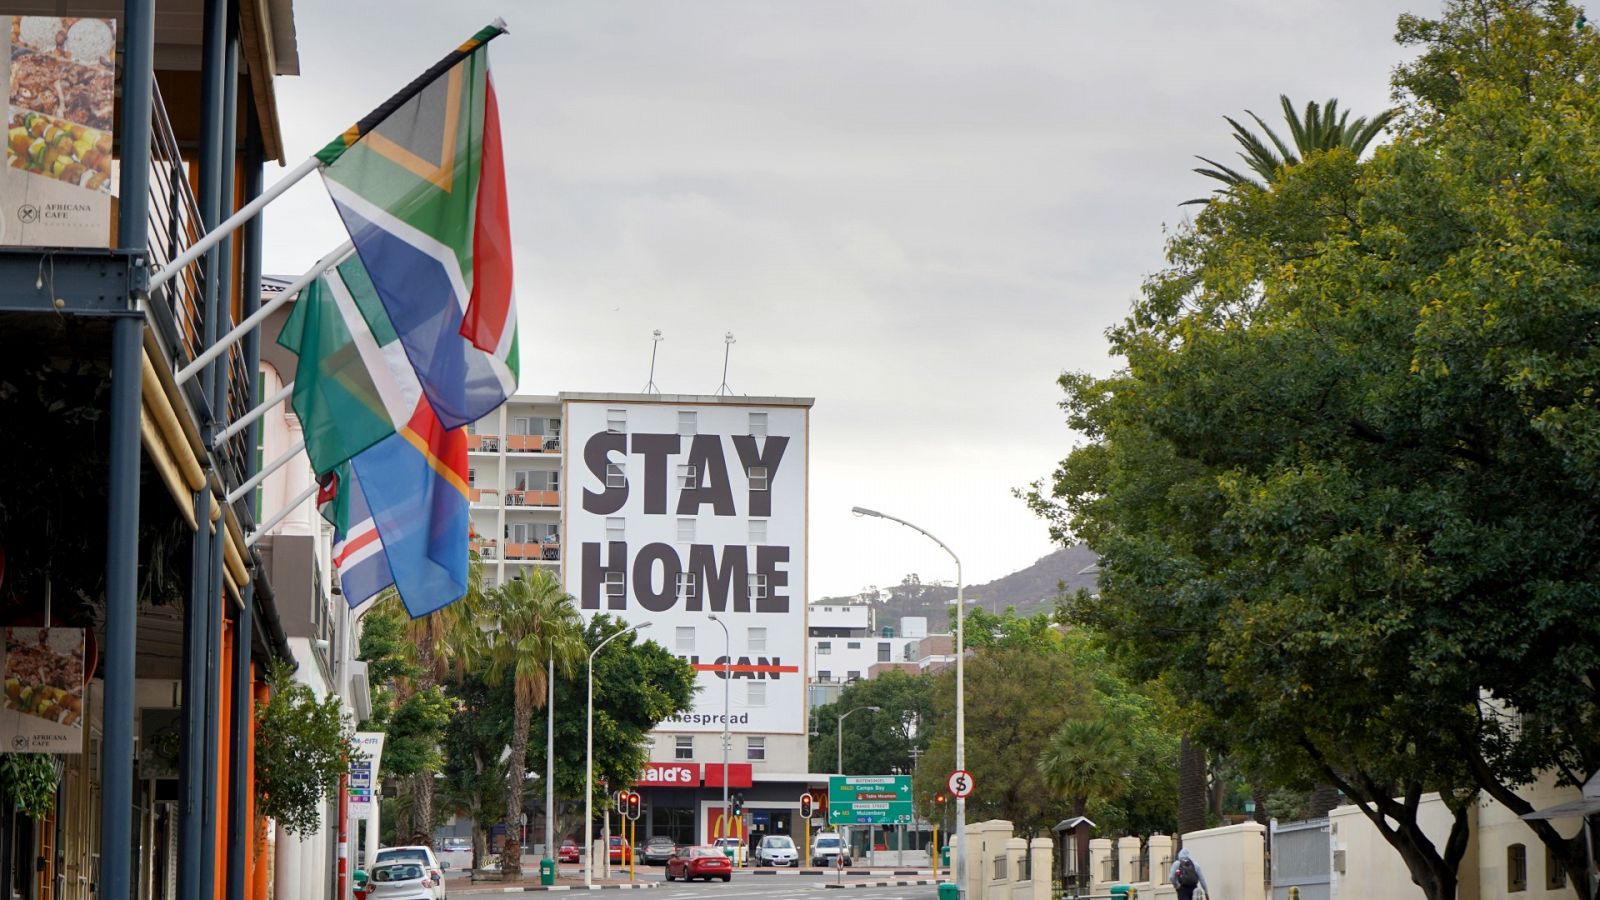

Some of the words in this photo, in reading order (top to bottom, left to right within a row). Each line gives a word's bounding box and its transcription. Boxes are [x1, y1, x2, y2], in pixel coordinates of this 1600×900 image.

[45, 204, 91, 212] AFRICANA
[582, 429, 791, 516] STAY
[581, 541, 790, 613] HOME
